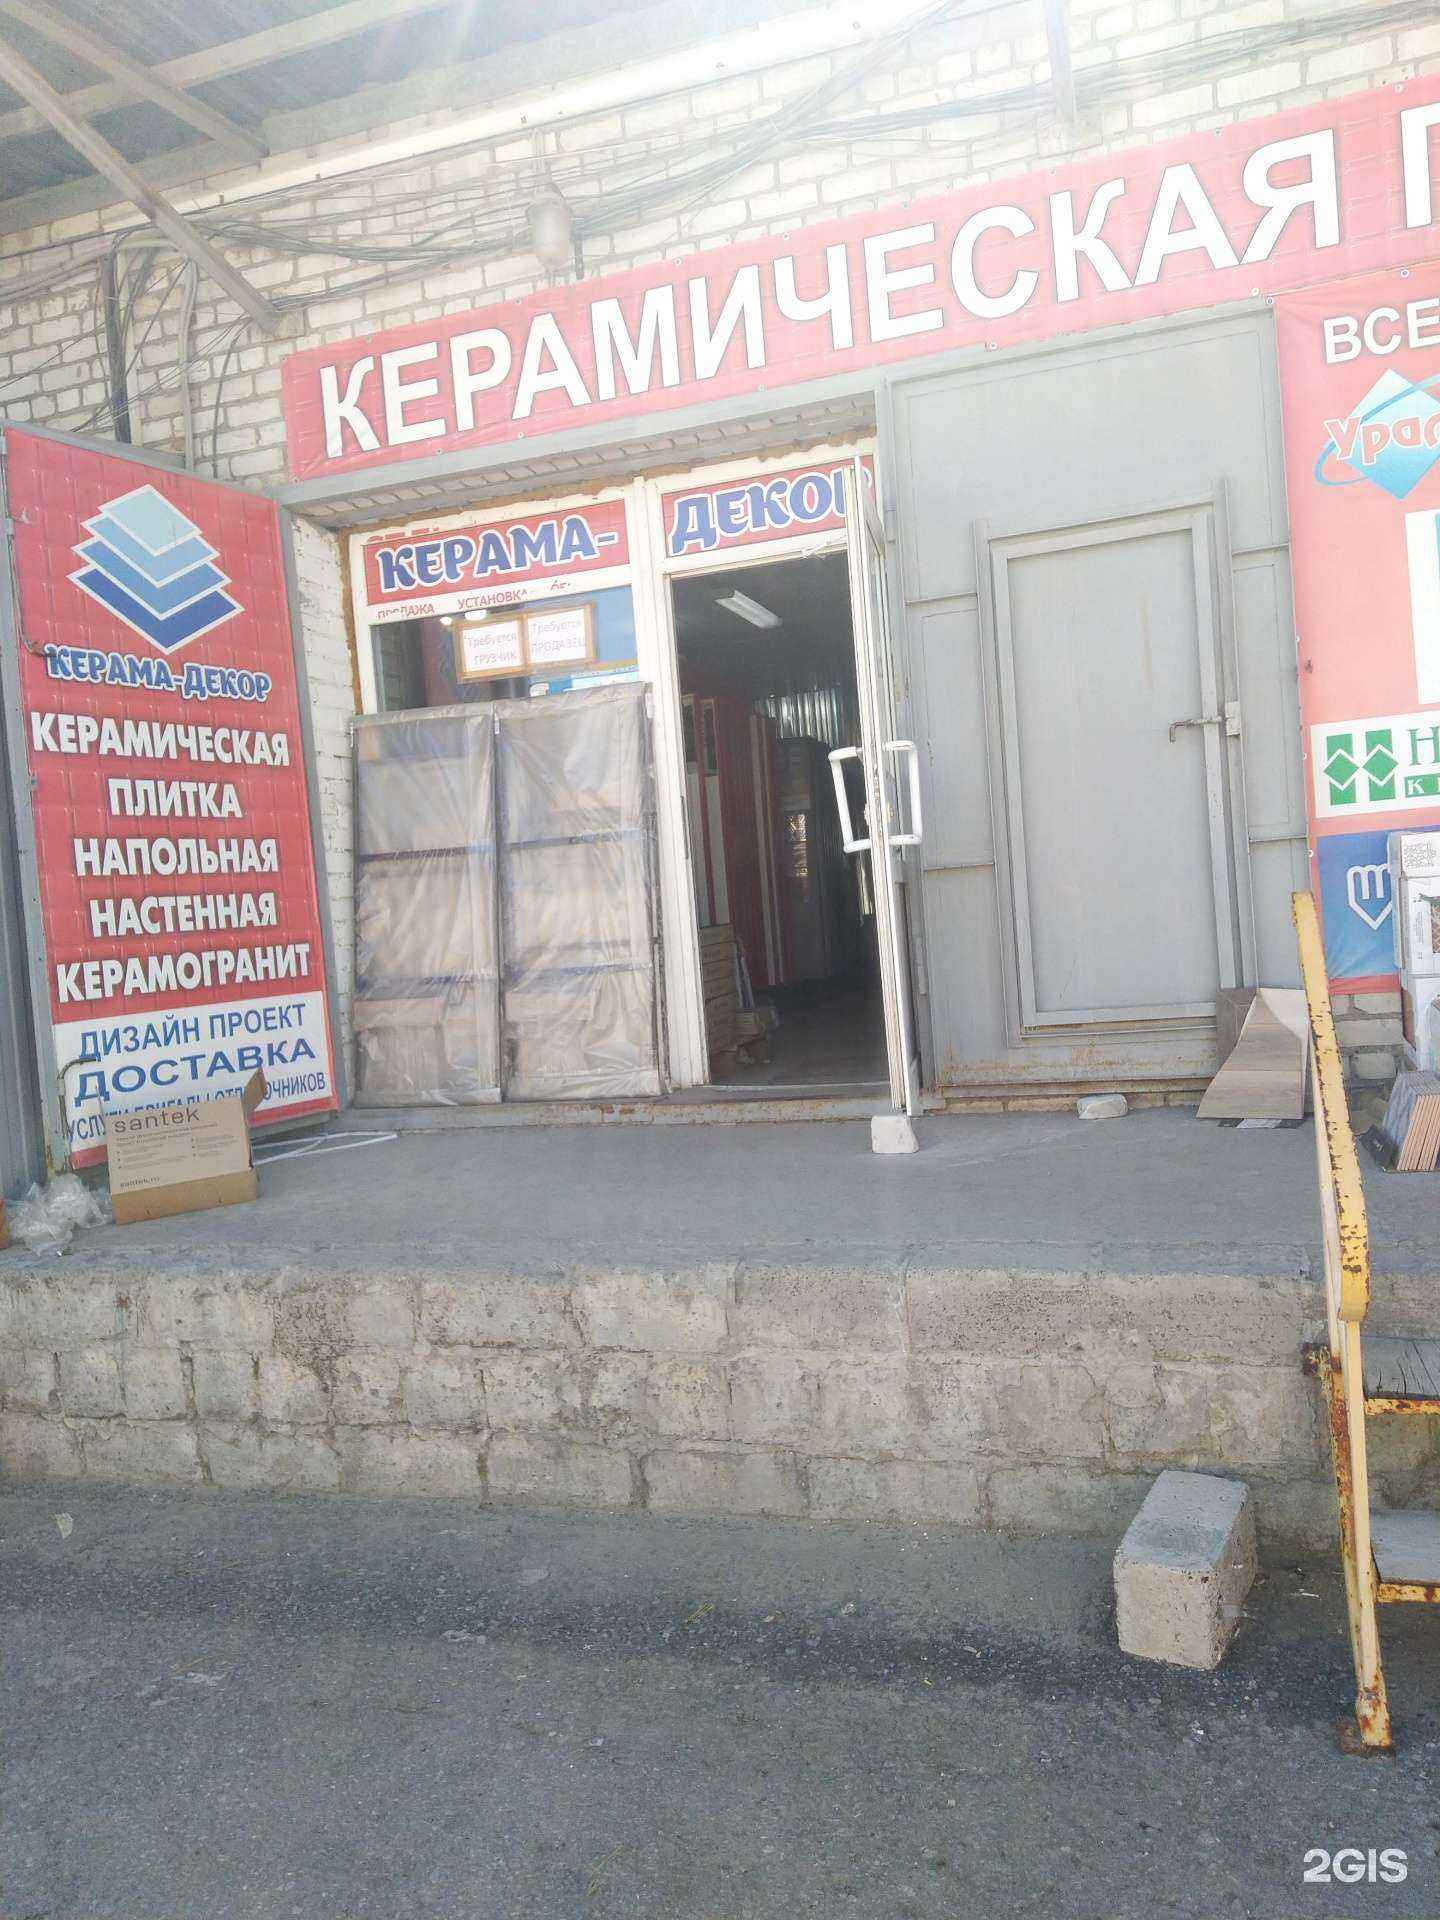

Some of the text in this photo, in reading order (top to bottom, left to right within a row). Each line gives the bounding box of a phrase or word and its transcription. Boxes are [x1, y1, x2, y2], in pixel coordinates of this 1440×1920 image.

[320, 128, 1341, 459] КЕРАМИЧЕСКАЯ
[378, 514, 617, 594] КЕРАМА-
[45, 643, 272, 702] КЕРАМА-ДЕКОР
[30, 711, 290, 767] КЕРАМИЧЕСКАЯ
[108, 778, 244, 819] ПЛИТКА
[74, 838, 280, 877] НАПОЛЬНАЯ
[89, 893, 278, 938] НАСТЕННАЯ
[57, 944, 311, 1004] КЕРАМОГРАНИТ
[79, 1003, 307, 1062] ДИЗАЙН ПРОЕКТ
[73, 1037, 317, 1107] ДОСТАВКА
[113, 1107, 201, 1134] santek
